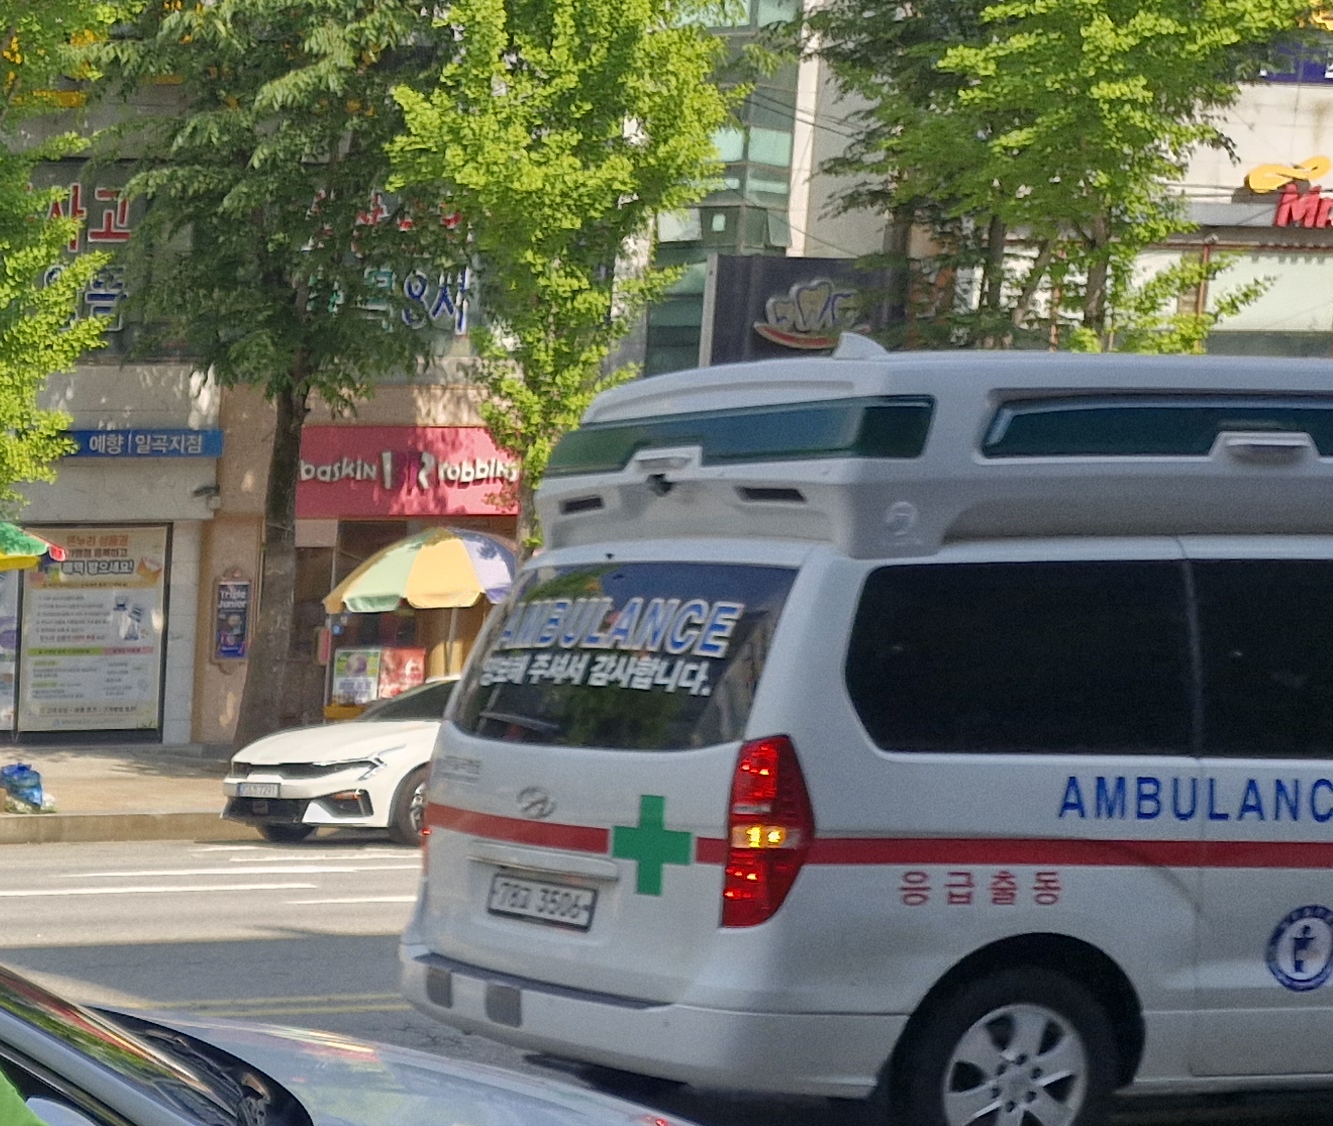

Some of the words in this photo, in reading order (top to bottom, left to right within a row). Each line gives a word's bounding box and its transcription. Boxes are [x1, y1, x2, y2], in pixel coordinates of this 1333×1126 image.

[89, 434, 123, 455] 예향
[135, 434, 202, 454] 일곡지점
[498, 597, 745, 659] AMBULANCE
[587, 653, 711, 696] 감사합니다.
[1058, 776, 1333, 822] AMBULANC
[900, 870, 1061, 907] 응급출동
